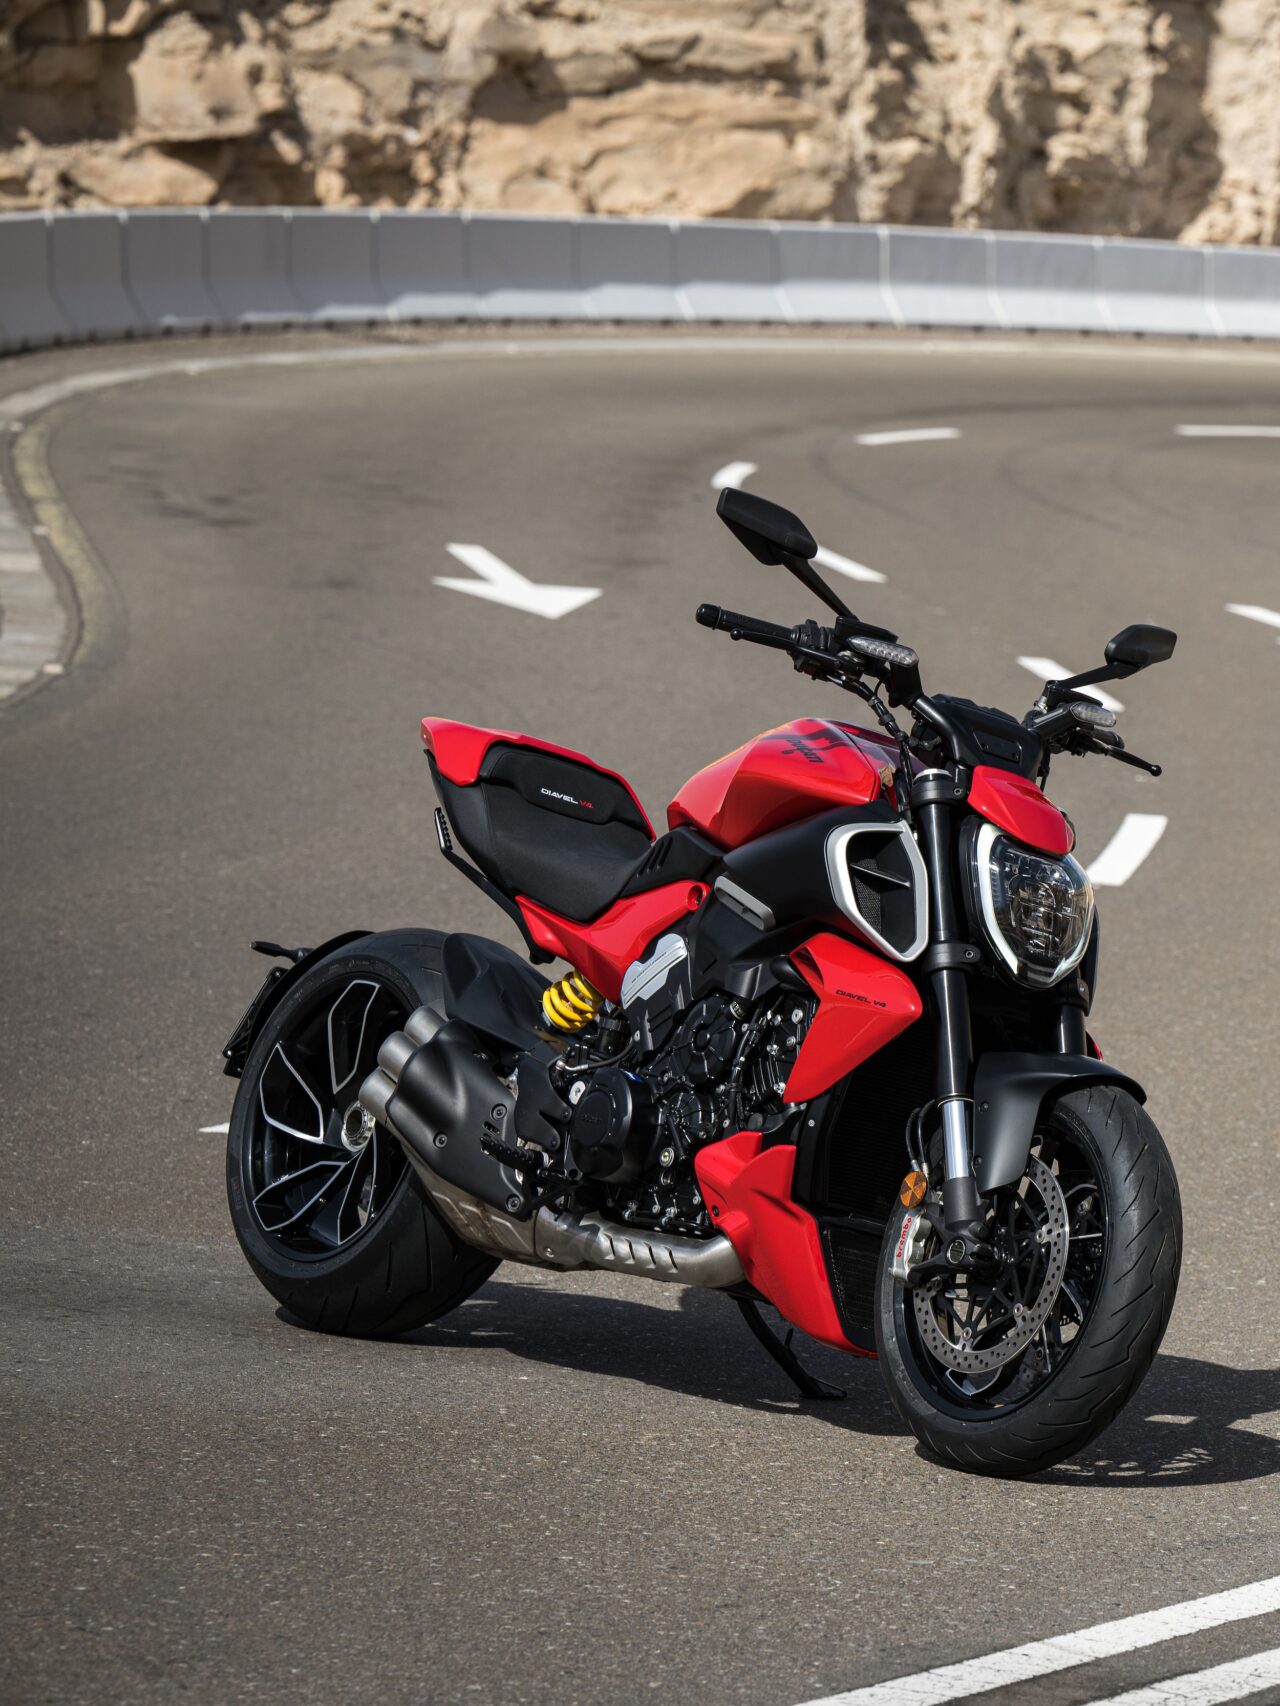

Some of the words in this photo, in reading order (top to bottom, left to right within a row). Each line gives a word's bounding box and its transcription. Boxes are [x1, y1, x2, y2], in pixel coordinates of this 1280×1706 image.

[541, 788, 579, 804] DIAVEL
[579, 800, 594, 809] V4
[835, 989, 871, 1004] DIAVEL
[873, 1000, 887, 1008] V4
[896, 1217, 912, 1258] brembo
